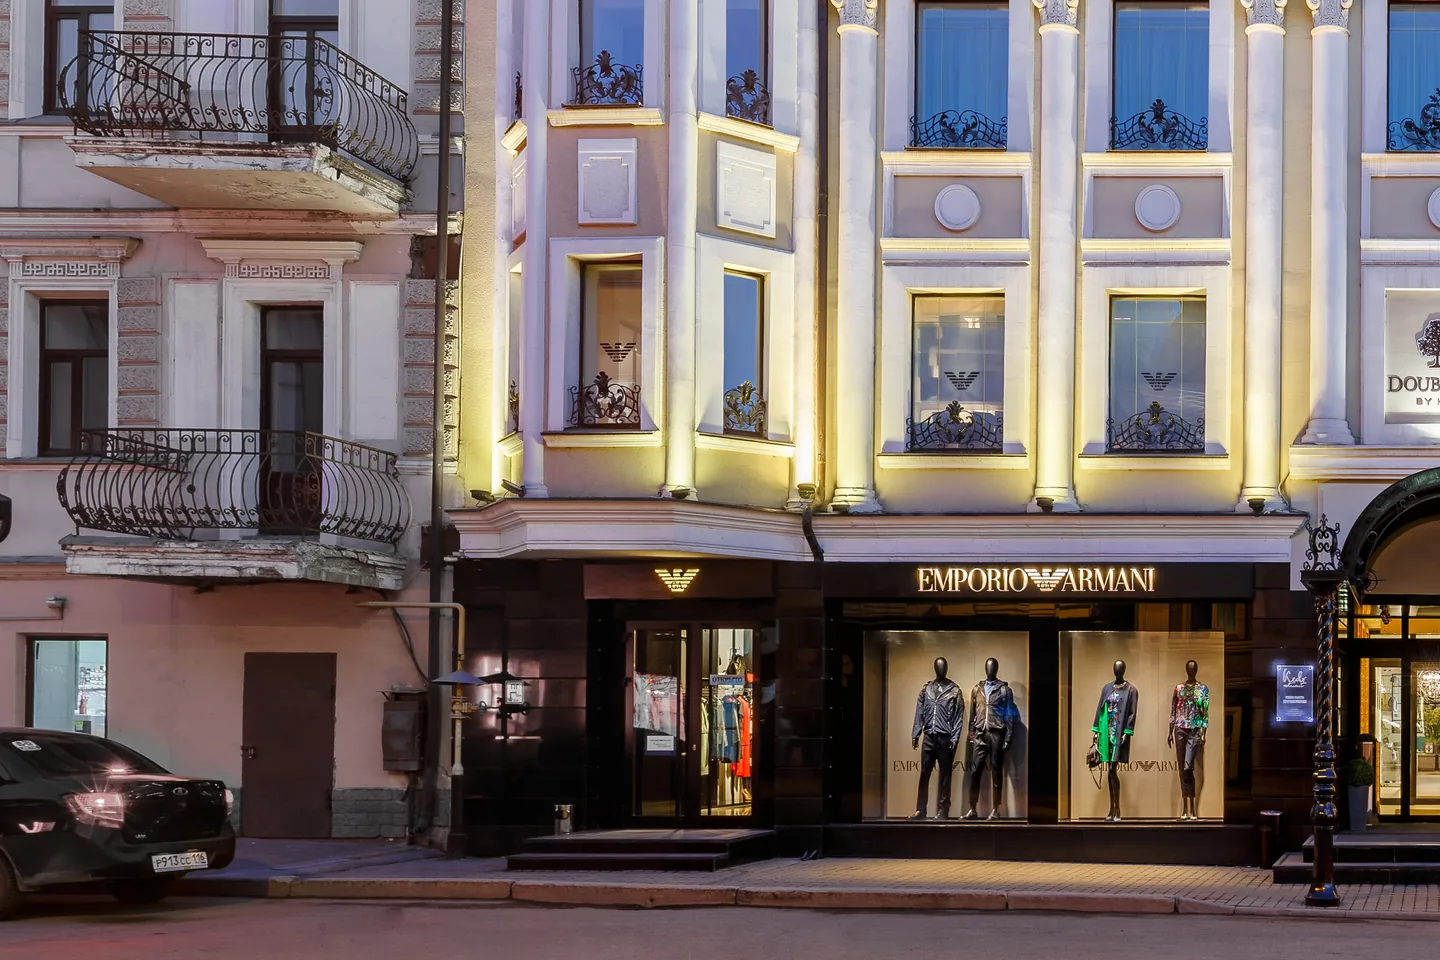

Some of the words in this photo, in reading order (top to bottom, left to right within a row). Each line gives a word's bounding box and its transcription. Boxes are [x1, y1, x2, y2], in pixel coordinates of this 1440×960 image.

[1416, 397, 1432, 406] BY
[917, 567, 1028, 592] EMPORIO
[1061, 567, 1156, 592] ARMANI
